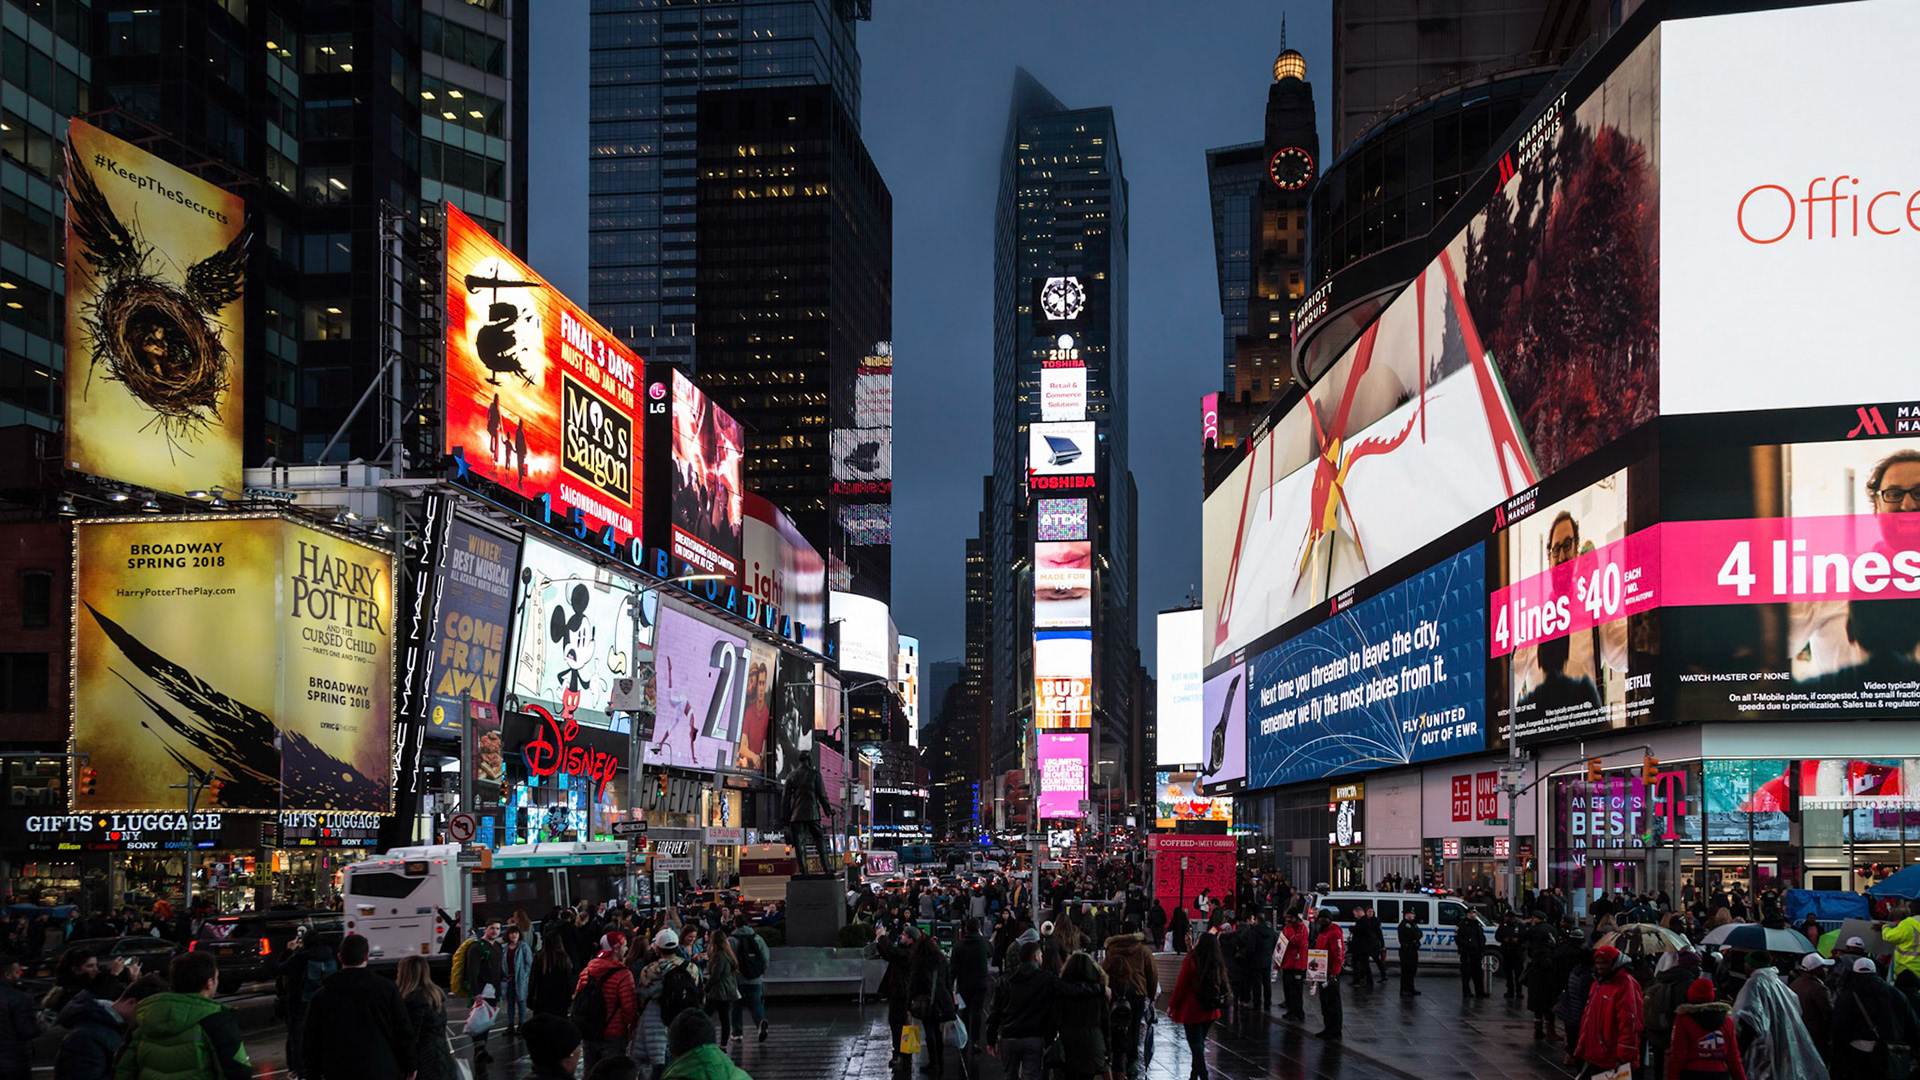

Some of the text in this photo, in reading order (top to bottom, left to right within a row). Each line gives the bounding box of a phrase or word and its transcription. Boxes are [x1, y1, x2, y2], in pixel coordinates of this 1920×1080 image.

[1518, 91, 1567, 153] MARRIOTT
[1518, 116, 1560, 170] MARQUIS
[94, 152, 229, 226] #KeepTheSecrets
[1297, 281, 1333, 322] MARRIOTT
[1297, 300, 1328, 337] MARQUIS
[560, 310, 634, 390] FINAL 3 DAYS
[1049, 348, 1079, 361] 2018
[1041, 359, 1086, 369] TOSHIBA
[561, 341, 634, 410] MUST END JAN 14TH
[1045, 391, 1082, 399] Commerce
[650, 402, 666, 414] LG
[567, 424, 629, 494] Saigon
[1029, 475, 1096, 490] TOSHIBA
[248, 488, 293, 499] LAMAR
[1507, 486, 1540, 511] MARRIOTT
[560, 483, 634, 536] SAIGONBROADWAY.COM
[1507, 500, 1536, 522] MARQUIS
[130, 542, 223, 556] BROADWAY
[127, 556, 225, 569] SPRING 2018
[298, 540, 381, 601] HARRY
[452, 548, 510, 588] BEST MUSICAL
[1717, 539, 1920, 596] 4 lines
[742, 558, 784, 609] Light
[1039, 573, 1065, 581] MADE
[1624, 567, 1642, 583] EACH
[116, 586, 236, 599] HarryPotterThePlay.com
[1054, 582, 1073, 590] YOU
[291, 576, 386, 636] POTTER
[1495, 562, 1621, 649] 4 lines $40
[326, 624, 353, 637] AND THE
[445, 611, 505, 651] COME
[302, 627, 377, 655] CURSED CHILD
[440, 638, 502, 678] FROM
[1261, 620, 1440, 708] Next time you threaten to leave the city,
[309, 676, 369, 697] BROADWAY
[435, 667, 498, 704] AWAY
[1625, 672, 1652, 692] NETFLIX
[1679, 672, 1790, 683] WATCH MASTER OF NONE
[1863, 680, 1920, 691] Video typically
[1042, 679, 1085, 697] BUD
[1260, 655, 1448, 736] remember we fly the most places from it.
[1728, 690, 1895, 702] On all T-Mobile plans, if congested, the small
[307, 690, 371, 710] SPRING 2018
[1035, 695, 1091, 712] LIGHT
[1738, 700, 1884, 712] speeds due to prioritization. Sales tax &
[1402, 707, 1466, 734] FLY UNITED
[1421, 720, 1478, 746] OUT OF EWR
[1042, 764, 1084, 772] TEXT DATA
[1044, 771, 1083, 779] IN OVER 140
[1477, 797, 1496, 816] QLO
[1654, 770, 1687, 840] T
[25, 813, 221, 832] GIFTS LUGGAGE
[278, 813, 381, 830] GIFTS LUGGAGE
[1572, 812, 1642, 836] BEST
[57, 841, 159, 850] Nikon SONY
[120, 832, 141, 841] NY
[341, 838, 362, 846] SONY
[1159, 839, 1195, 847] COFFEED
[656, 840, 691, 855] FOREVER 21
[1423, 934, 1456, 946] NYP
